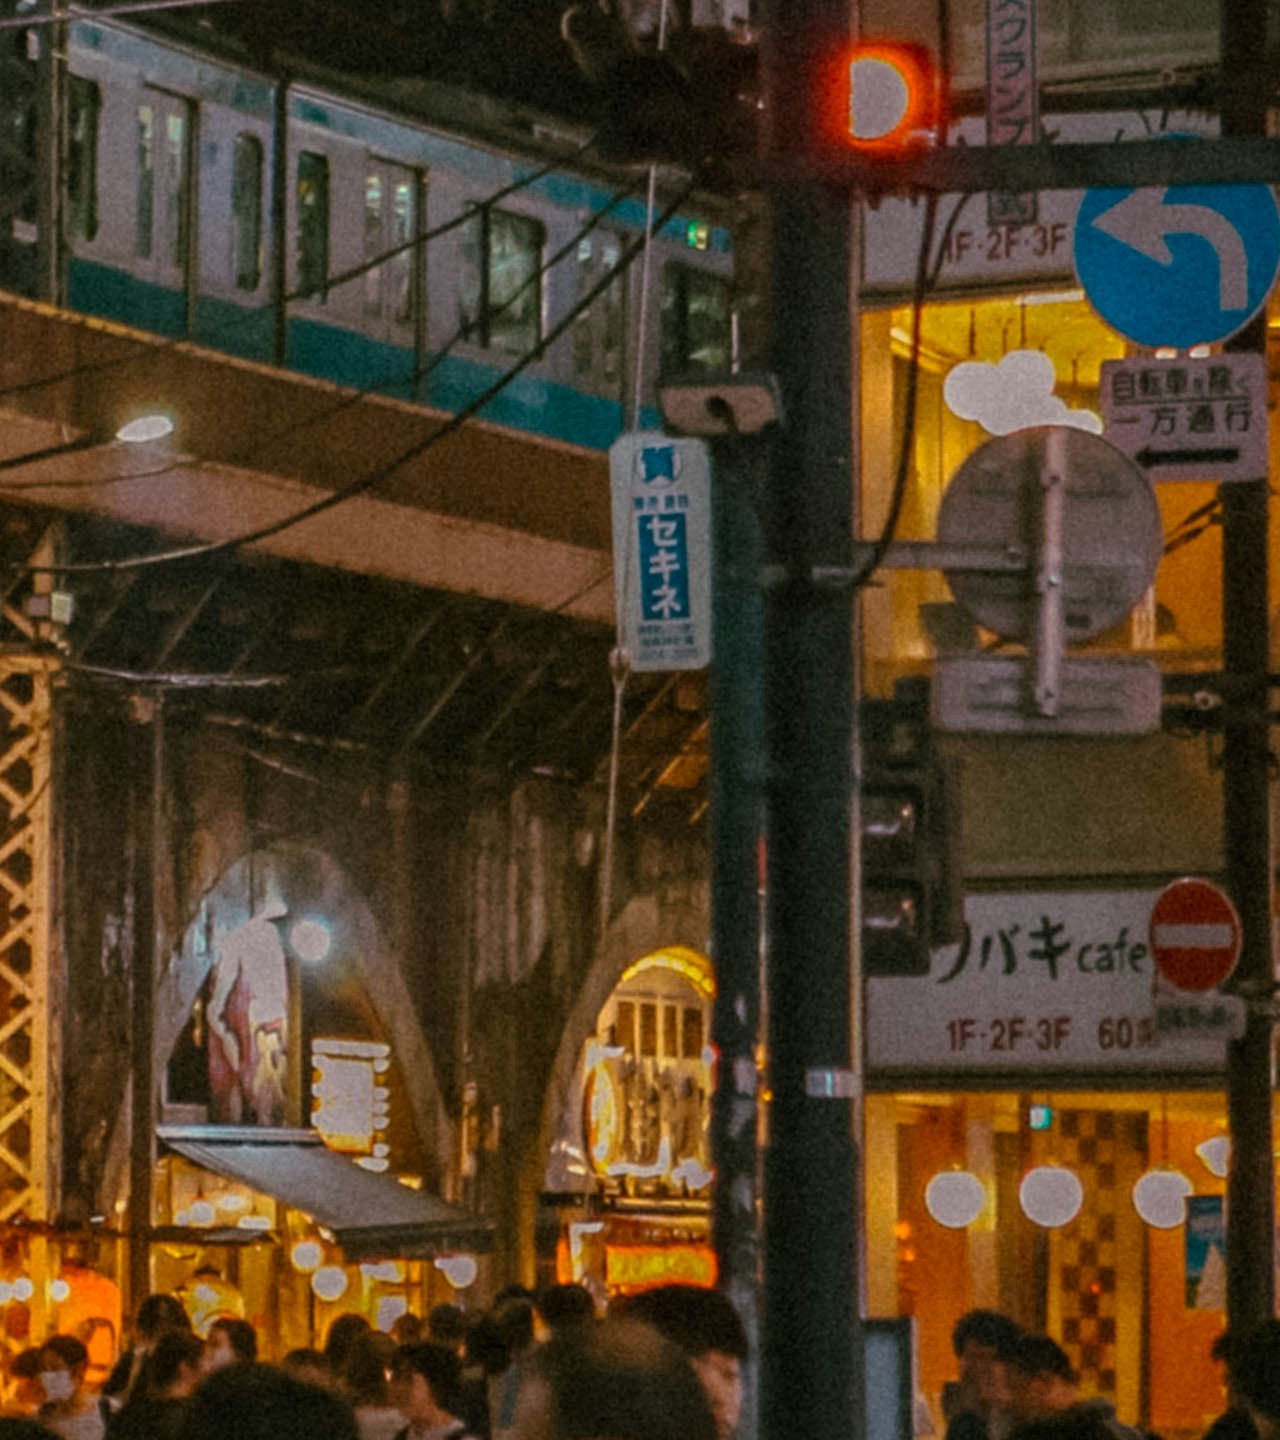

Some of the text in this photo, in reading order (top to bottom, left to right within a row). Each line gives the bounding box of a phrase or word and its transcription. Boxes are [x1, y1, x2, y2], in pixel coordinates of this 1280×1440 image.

[1112, 402, 1252, 435] 一方通行
[646, 516, 682, 619] セキネ
